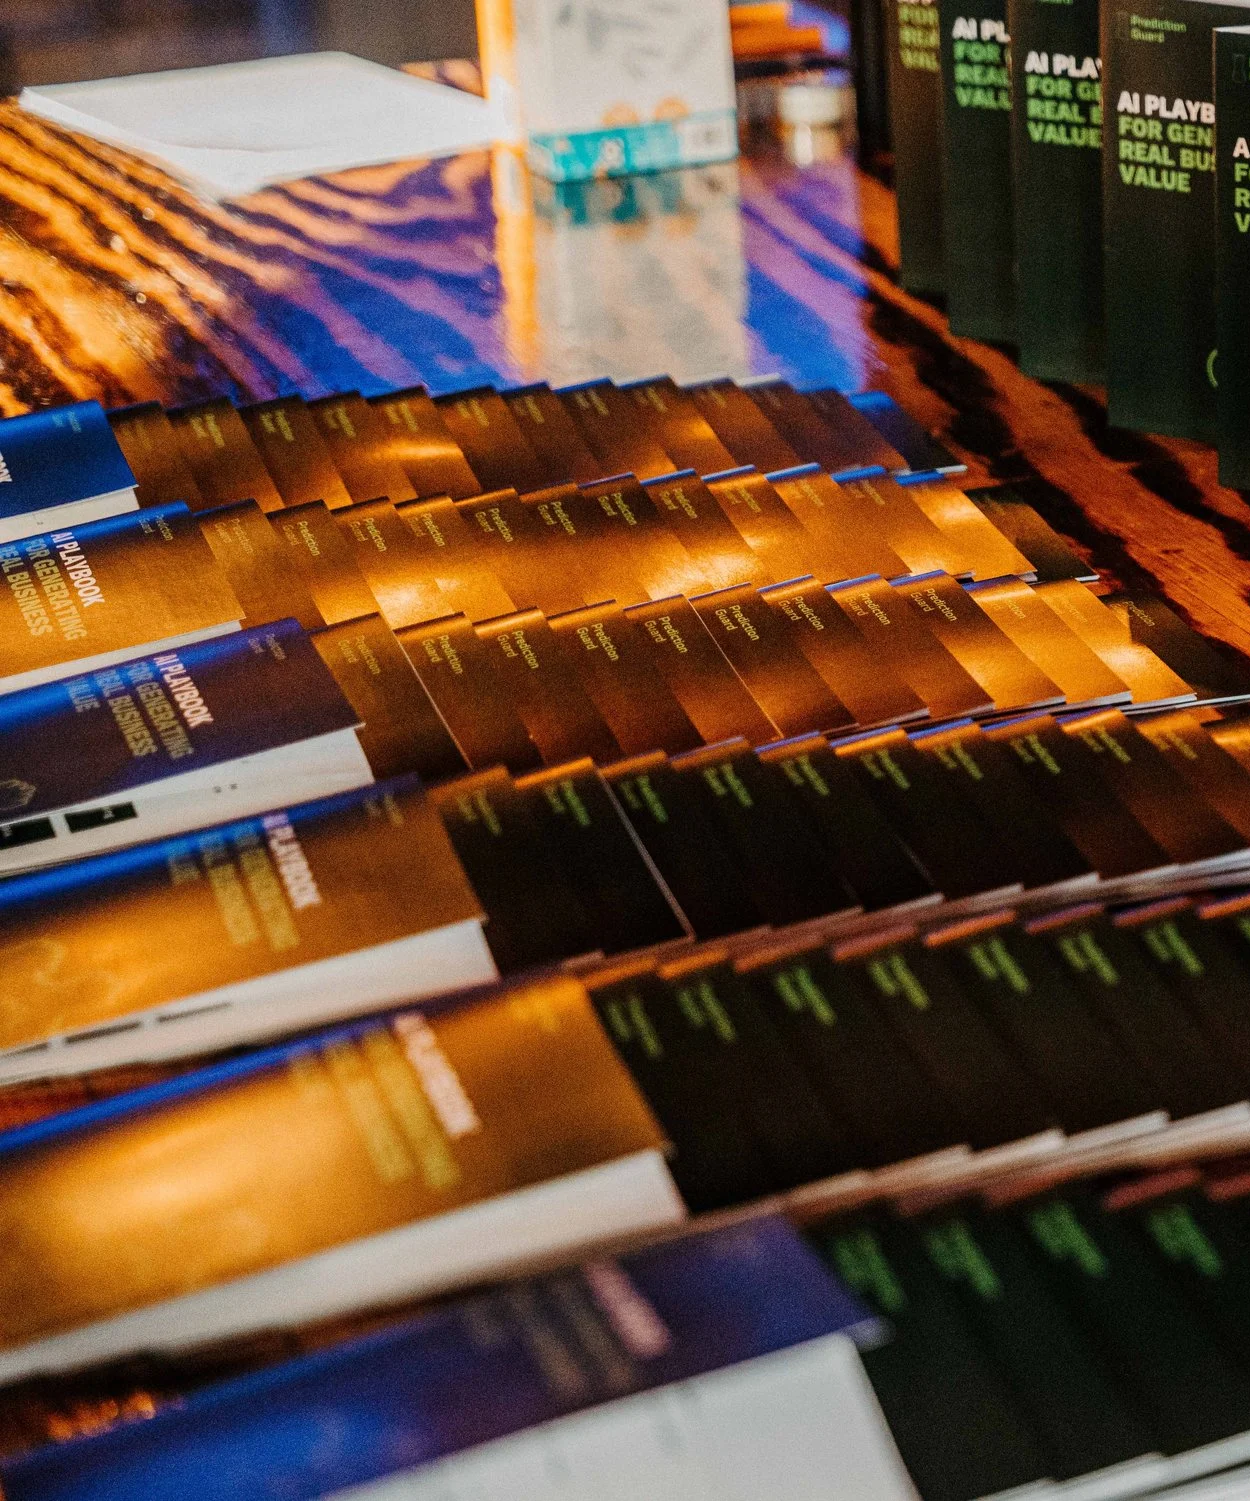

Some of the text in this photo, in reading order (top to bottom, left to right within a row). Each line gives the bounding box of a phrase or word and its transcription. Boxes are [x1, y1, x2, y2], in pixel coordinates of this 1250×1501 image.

[952, 17, 978, 40] AI
[1130, 14, 1187, 33] Prediction
[1025, 50, 1049, 74] AI
[1026, 75, 1073, 99] FOR
[1027, 98, 1085, 124] REAL
[1117, 91, 1140, 114] AI
[1118, 115, 1163, 141] FOR
[1119, 139, 1176, 167] REAL
[1118, 163, 1191, 193] VALUE
[363, 517, 388, 552] Prediction
[420, 511, 446, 547] Prediction
[488, 507, 514, 543] Prediction
[51, 532, 105, 608] AI PLAYBOOK
[7, 571, 53, 636] BUSINESS
[33, 558, 88, 641] GENERATING
[778, 599, 801, 622] Guard
[791, 595, 825, 631] Prediction
[858, 592, 891, 626] Prediction
[910, 591, 934, 613] Guard
[925, 588, 957, 622] Prediction
[644, 620, 667, 644] Guard
[658, 615, 689, 654] Prediction
[715, 608, 738, 632] Guard
[729, 604, 760, 642] Prediction
[422, 638, 443, 664] Guard
[497, 634, 518, 659] Guard
[511, 630, 540, 670] Prediction
[576, 626, 598, 651] Guard
[591, 622, 620, 662] Prediction
[437, 634, 464, 675] Prediction
[159, 663, 215, 730] PLAYBOOK
